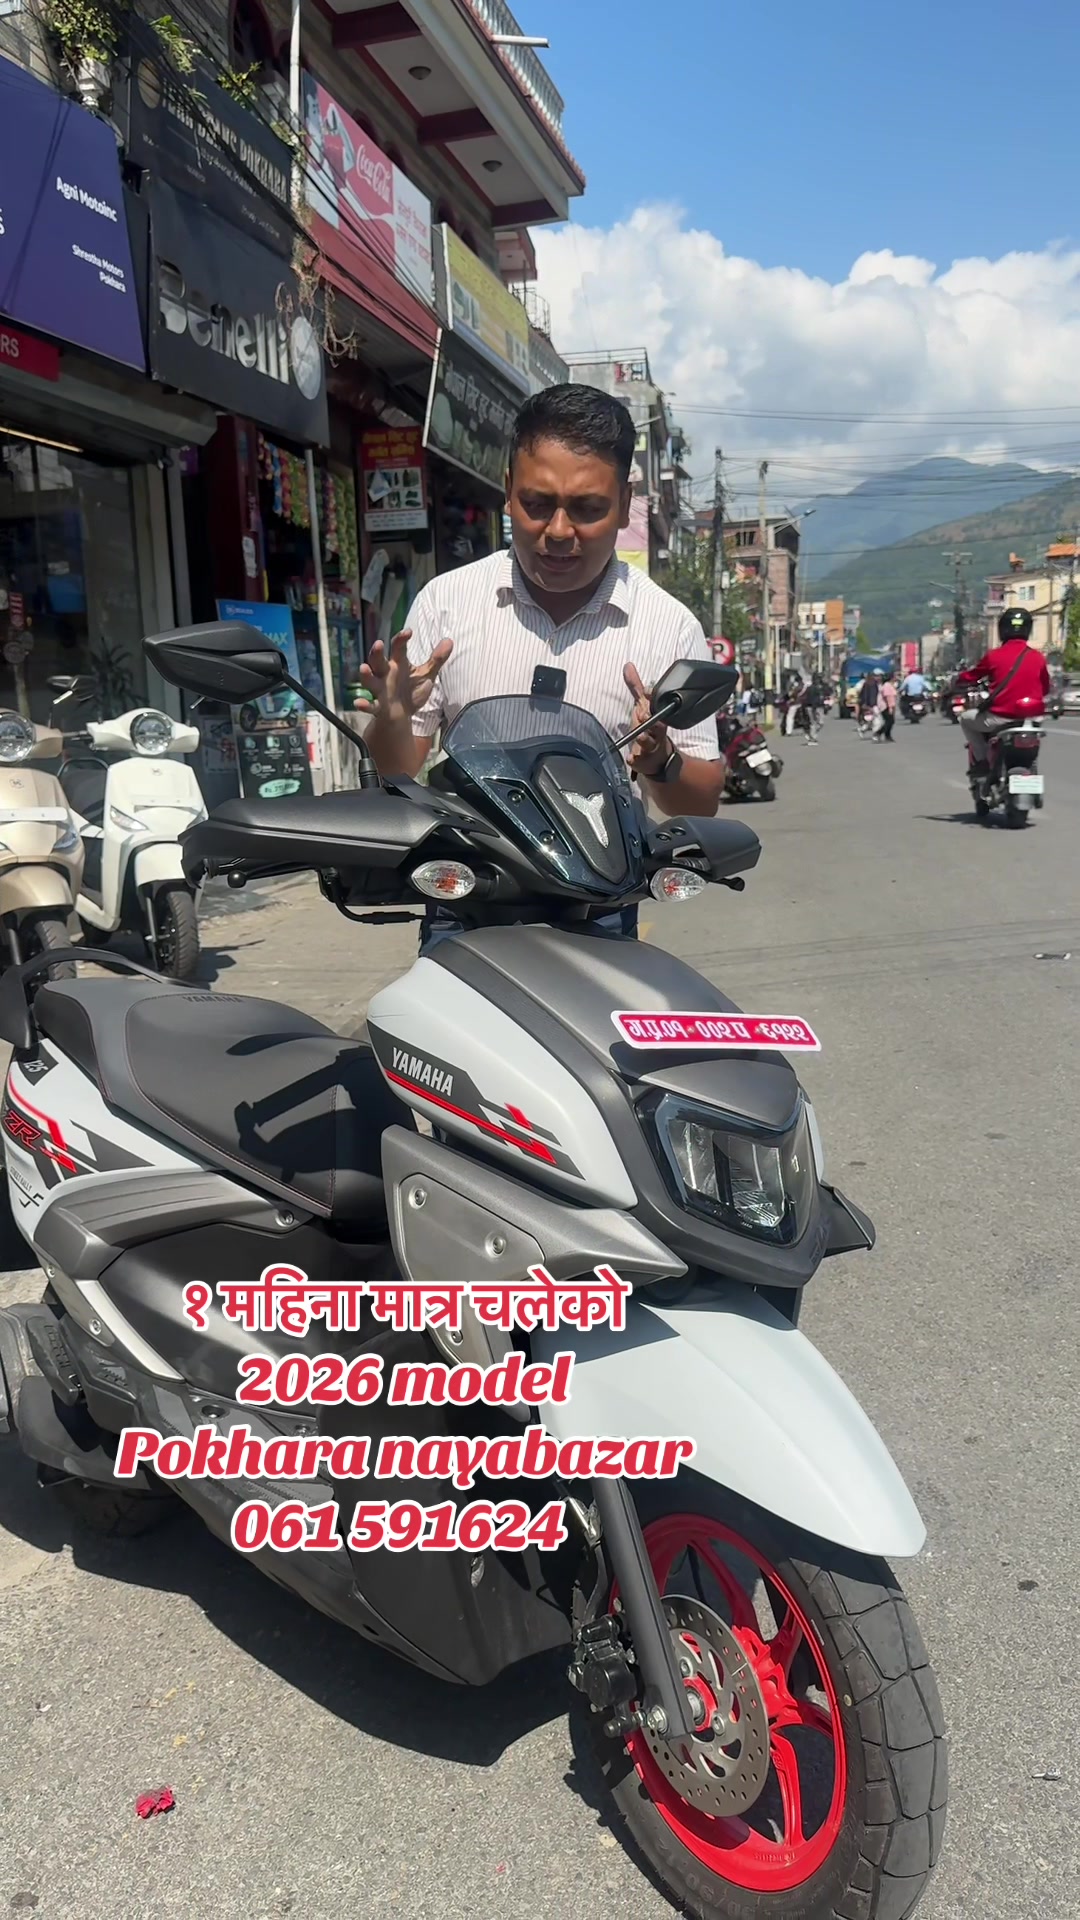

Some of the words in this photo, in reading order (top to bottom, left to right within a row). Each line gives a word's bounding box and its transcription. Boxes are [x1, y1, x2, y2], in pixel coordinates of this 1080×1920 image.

[56, 176, 79, 200] Agni
[79, 188, 118, 222] Motoinc
[101, 258, 125, 279] Motors
[695, 1020, 732, 1040] ००२
[23, 1059, 49, 1073] 125
[392, 1046, 454, 1097] YAMAHA
